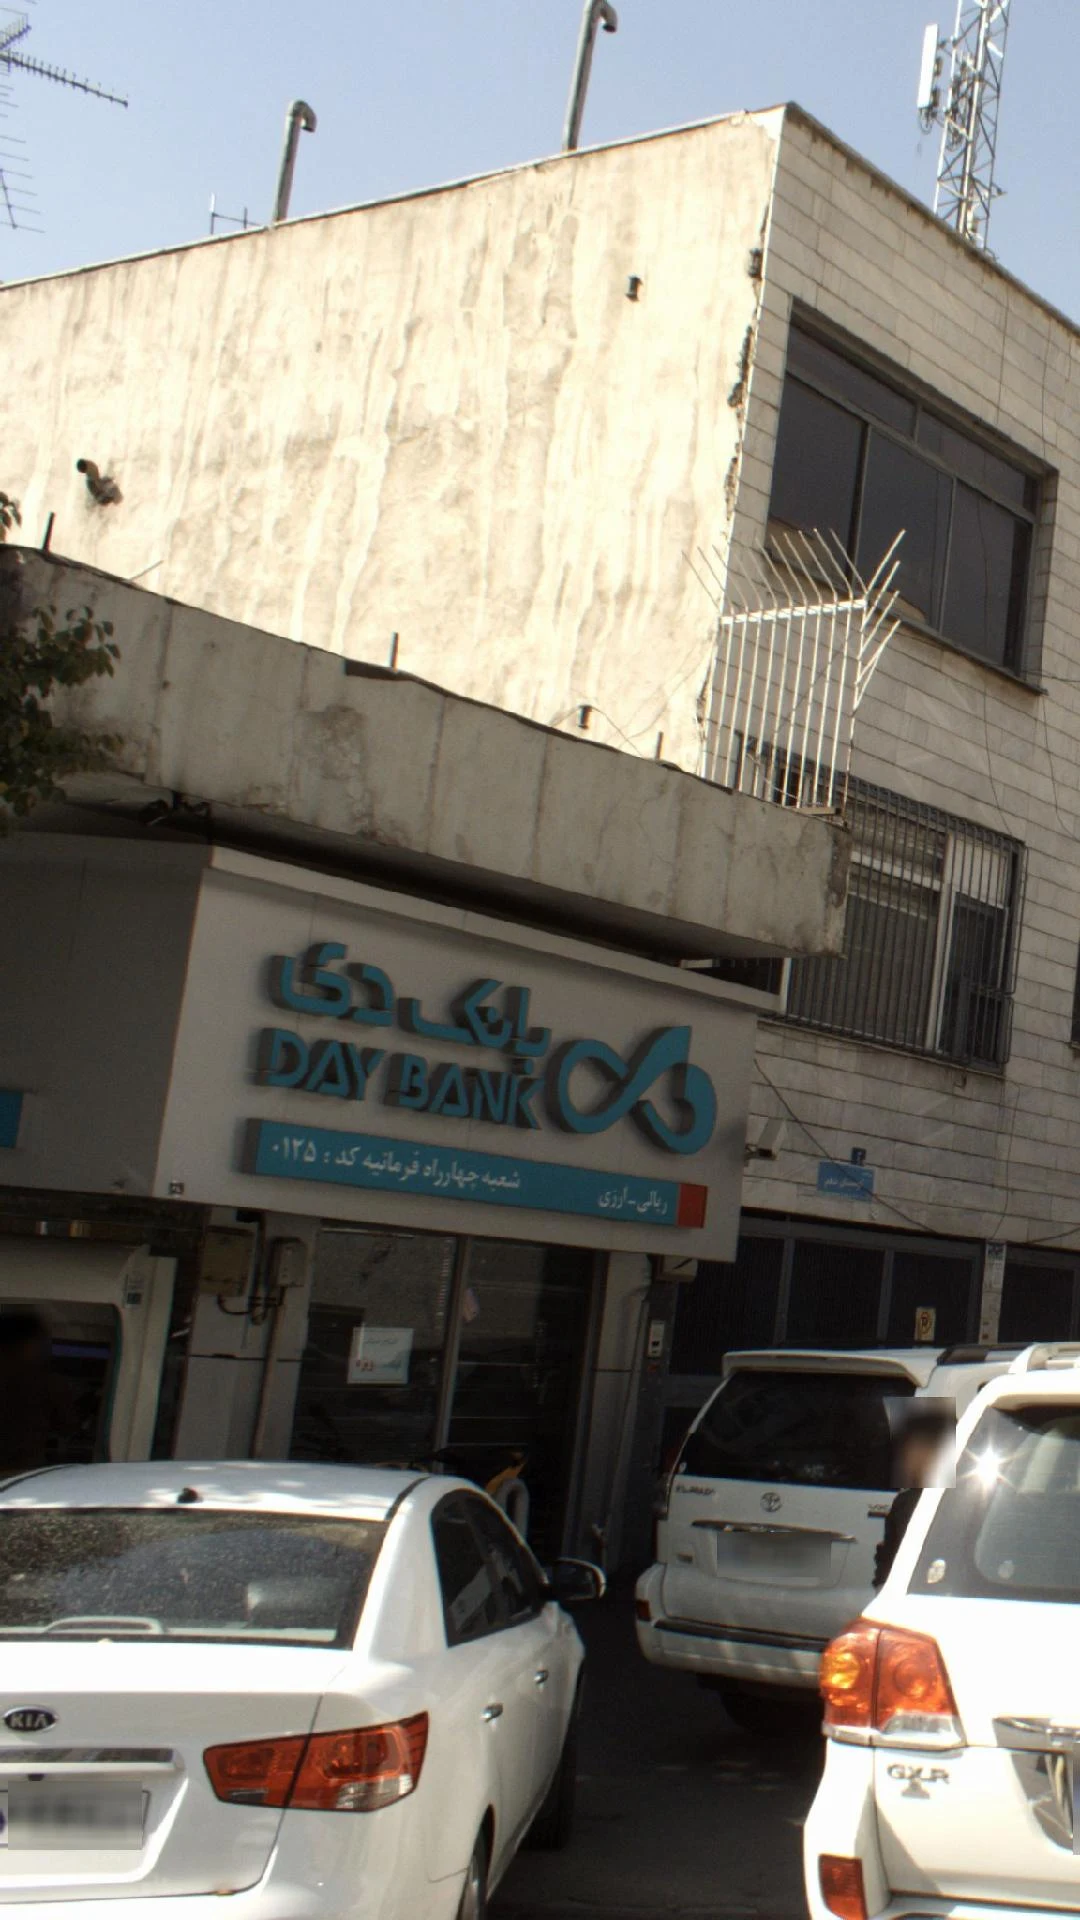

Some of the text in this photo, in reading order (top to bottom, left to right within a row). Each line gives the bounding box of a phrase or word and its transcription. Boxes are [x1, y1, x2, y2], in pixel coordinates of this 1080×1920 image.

[273, 941, 551, 1073] بانک دی
[261, 1027, 545, 1130] DAY BANK
[271, 1135, 317, 1163] ۰۱۲۵
[334, 1144, 362, 1166] کد
[361, 1149, 420, 1182] فرمانیه
[422, 1157, 480, 1191] چهارراه
[480, 1169, 521, 1192] شعبه
[10, 1712, 49, 1729] KIA
[886, 1763, 951, 1785] GXR
